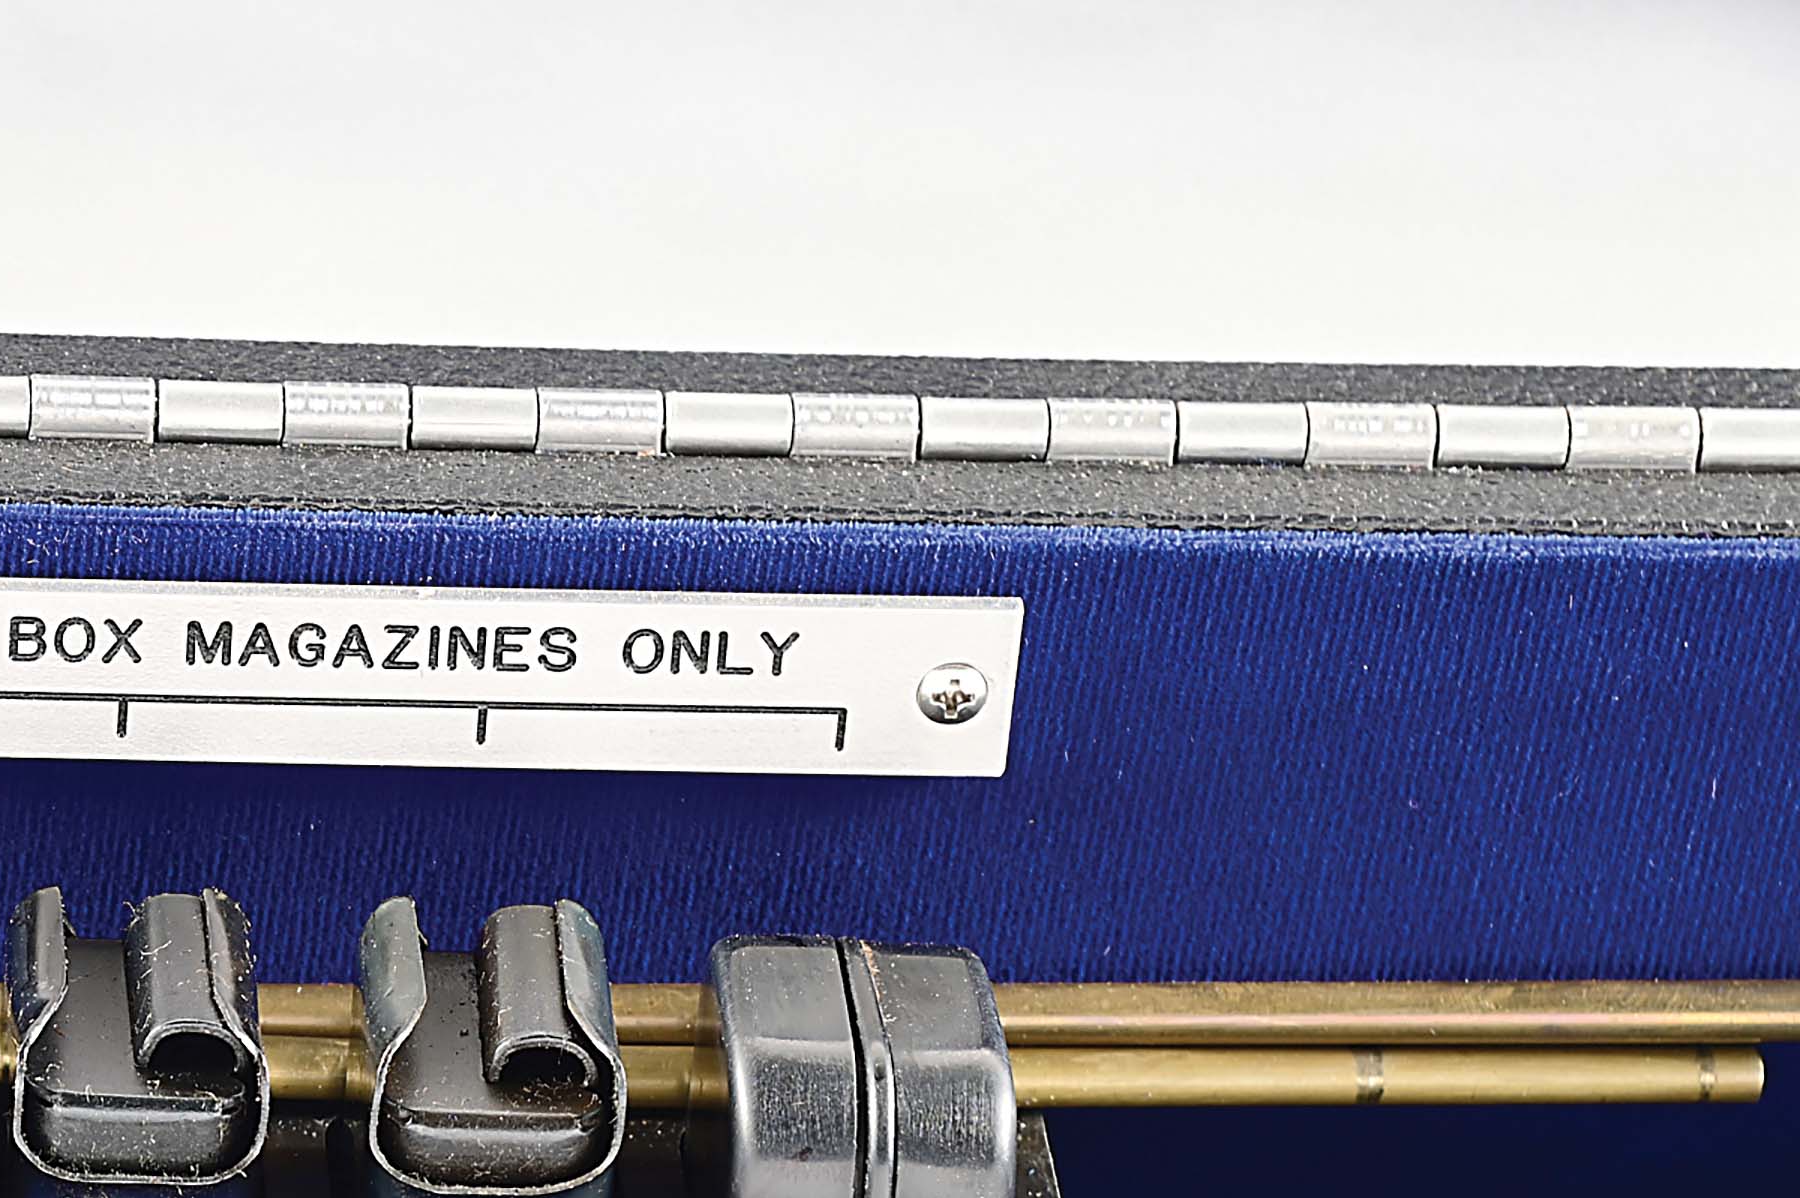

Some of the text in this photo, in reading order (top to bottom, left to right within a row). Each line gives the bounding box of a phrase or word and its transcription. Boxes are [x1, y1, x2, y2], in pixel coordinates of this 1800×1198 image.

[8, 615, 143, 664] BOX
[185, 620, 577, 673] MAGAZINES
[622, 628, 800, 677] ONLY
